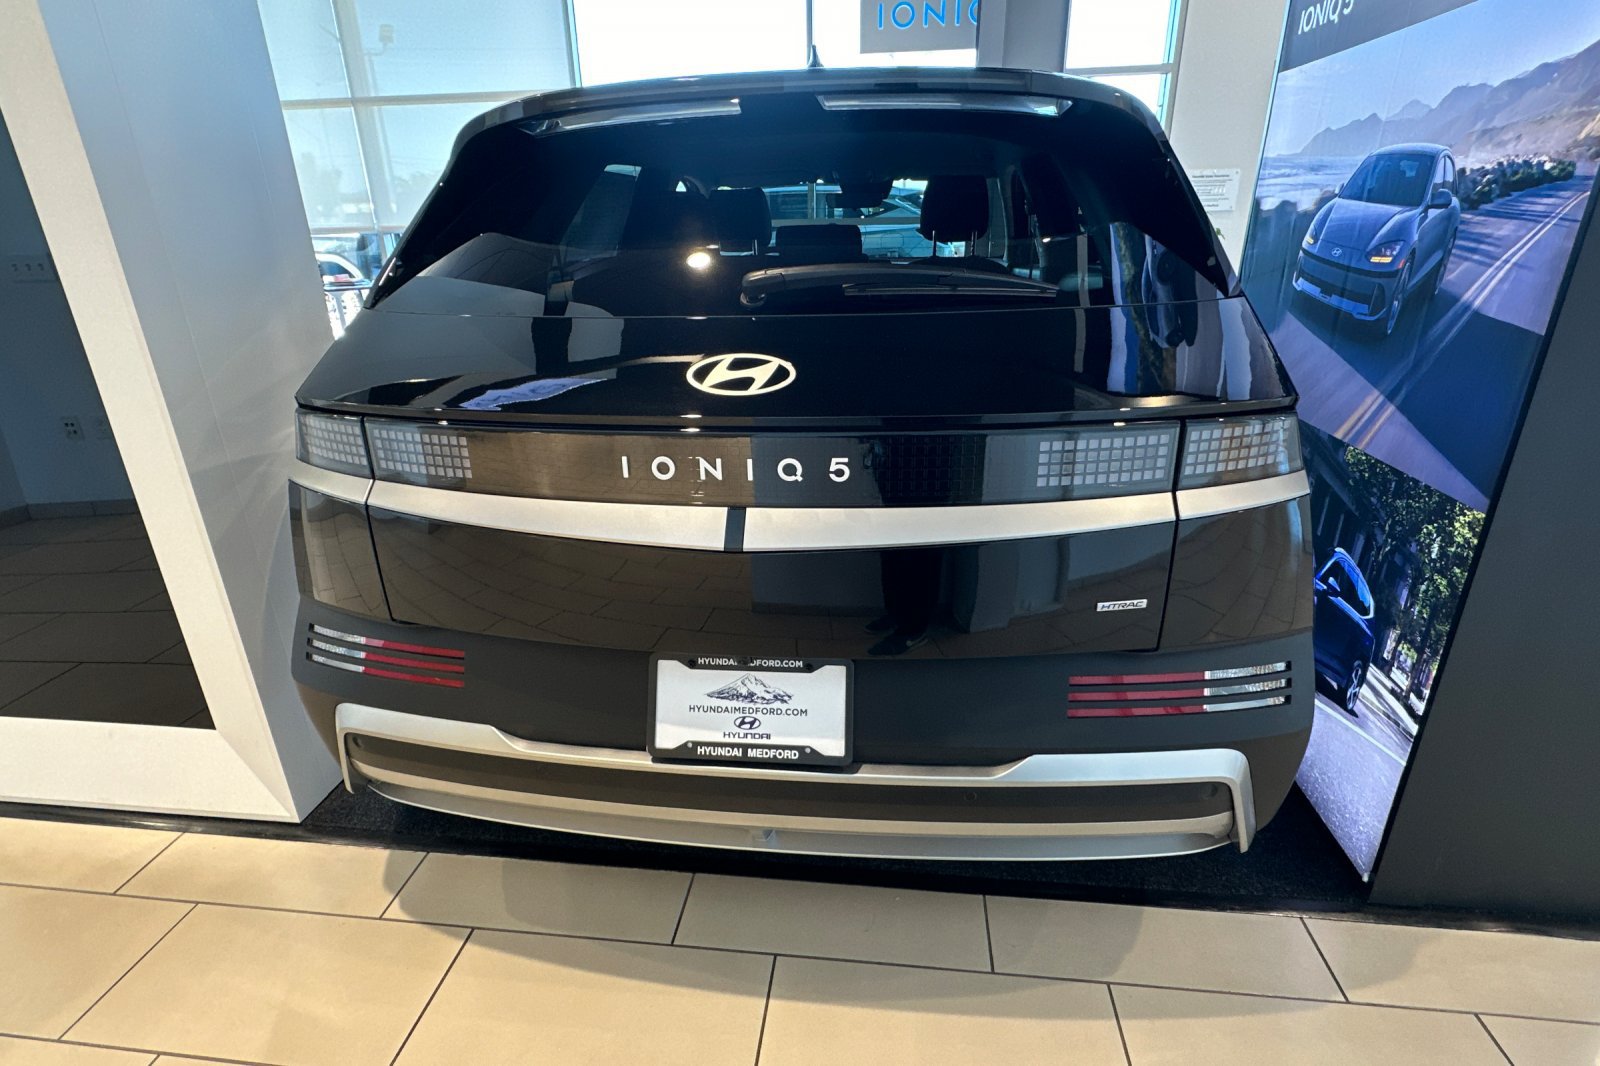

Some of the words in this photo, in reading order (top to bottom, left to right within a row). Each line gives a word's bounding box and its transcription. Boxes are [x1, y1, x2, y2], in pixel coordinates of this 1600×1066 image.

[1298, 0, 1342, 35] IONIQ
[621, 455, 803, 482] IONIQ
[828, 457, 850, 482] 5
[1100, 601, 1145, 610] HTRAC
[688, 705, 808, 716] HYUNDAIMEDFORD.COM
[723, 731, 771, 740] HYUNDAI
[697, 746, 742, 757] HYUNDAI
[748, 748, 799, 760] MEDFORD
